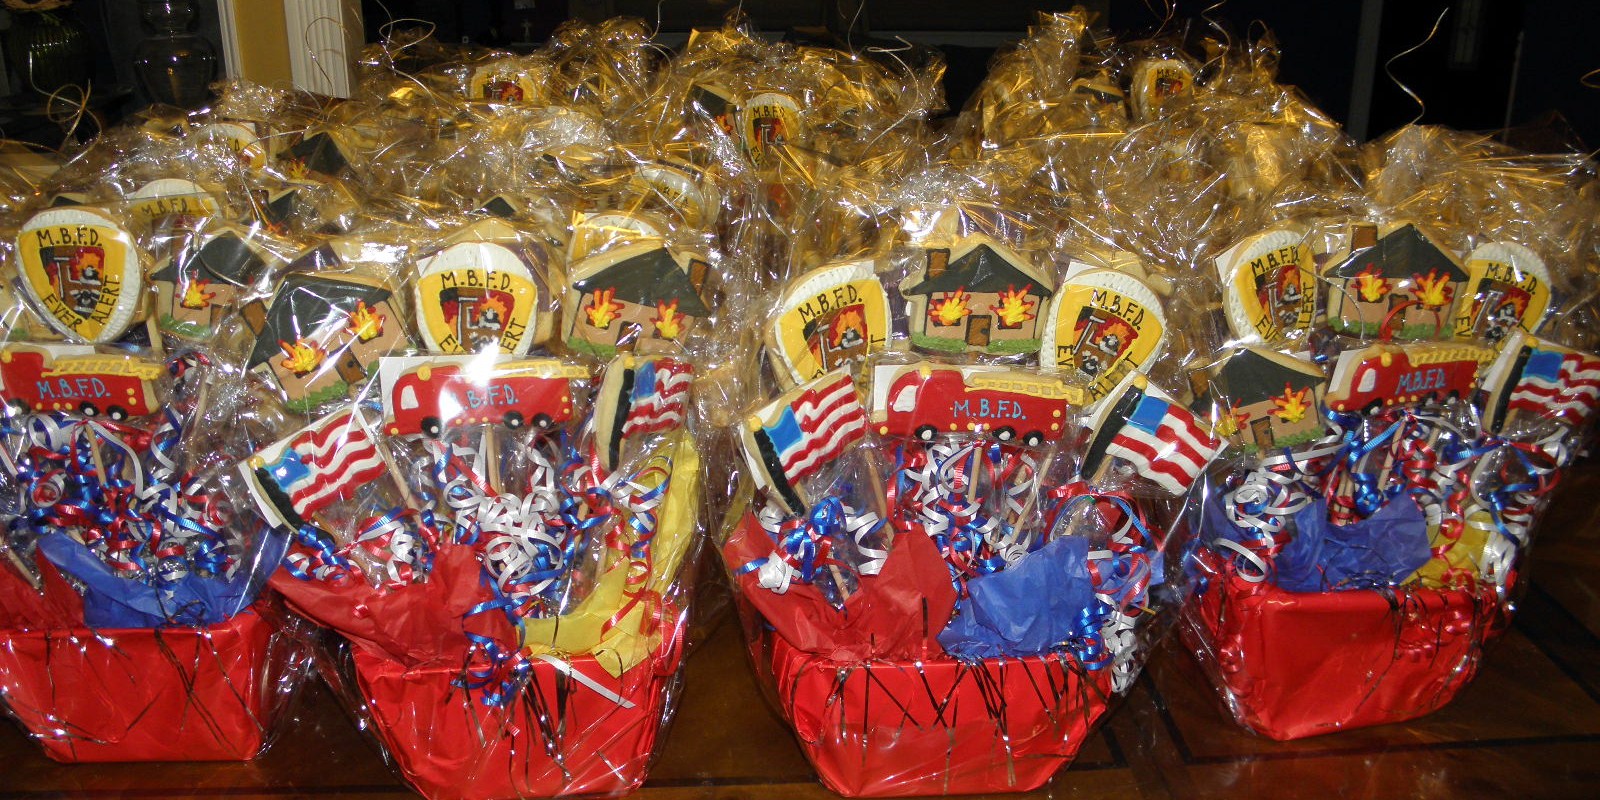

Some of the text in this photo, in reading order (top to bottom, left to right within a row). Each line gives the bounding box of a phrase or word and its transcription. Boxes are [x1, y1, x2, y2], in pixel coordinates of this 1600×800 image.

[36, 227, 102, 248] M.B.F.D.
[440, 269, 514, 293] M.B.F.D.
[45, 293, 84, 332] EVER
[91, 274, 121, 325] ALERT
[797, 284, 863, 324] M.B.F.D.
[1089, 288, 1146, 331] M.B.F.D.
[36, 377, 112, 400] M.B.F.D.
[953, 398, 1027, 420] M.B.F.D.
